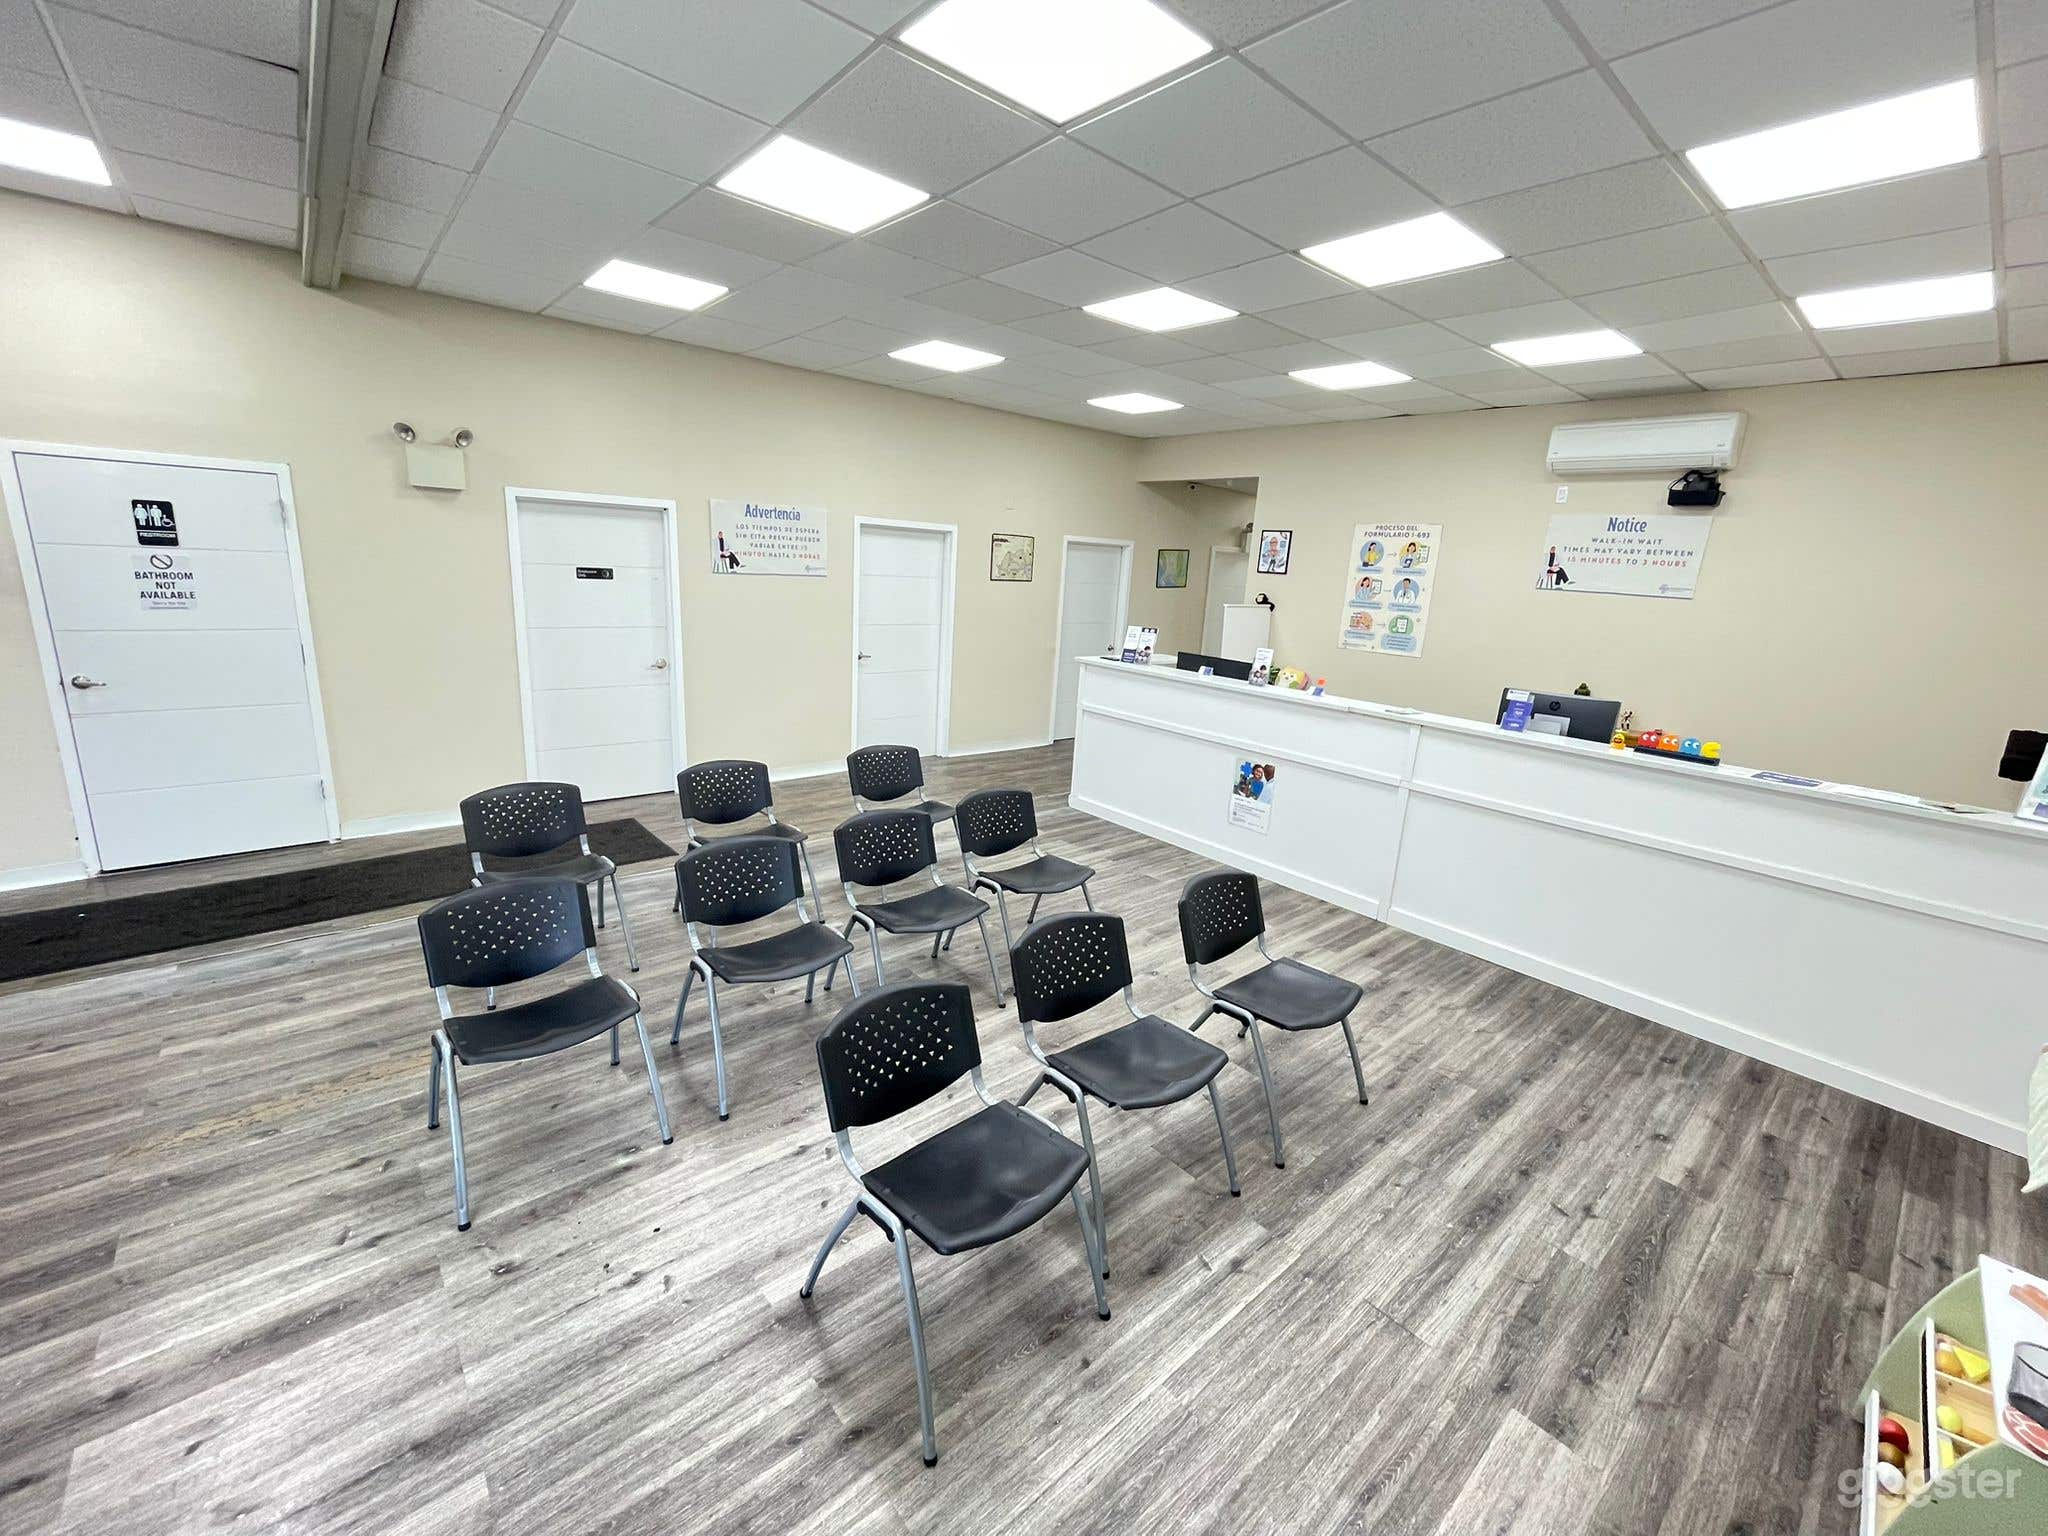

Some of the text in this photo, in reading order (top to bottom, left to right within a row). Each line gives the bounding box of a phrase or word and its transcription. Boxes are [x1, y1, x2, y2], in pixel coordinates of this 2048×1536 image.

[745, 504, 801, 521] Advertencia
[1607, 517, 1647, 533] Notice
[1646, 548, 1694, 557] BETWEEN
[1580, 556, 1621, 564] MINUTES
[135, 571, 194, 580] BATHROOM
[155, 581, 176, 590] NOT
[140, 591, 196, 599] AVAILABLE
